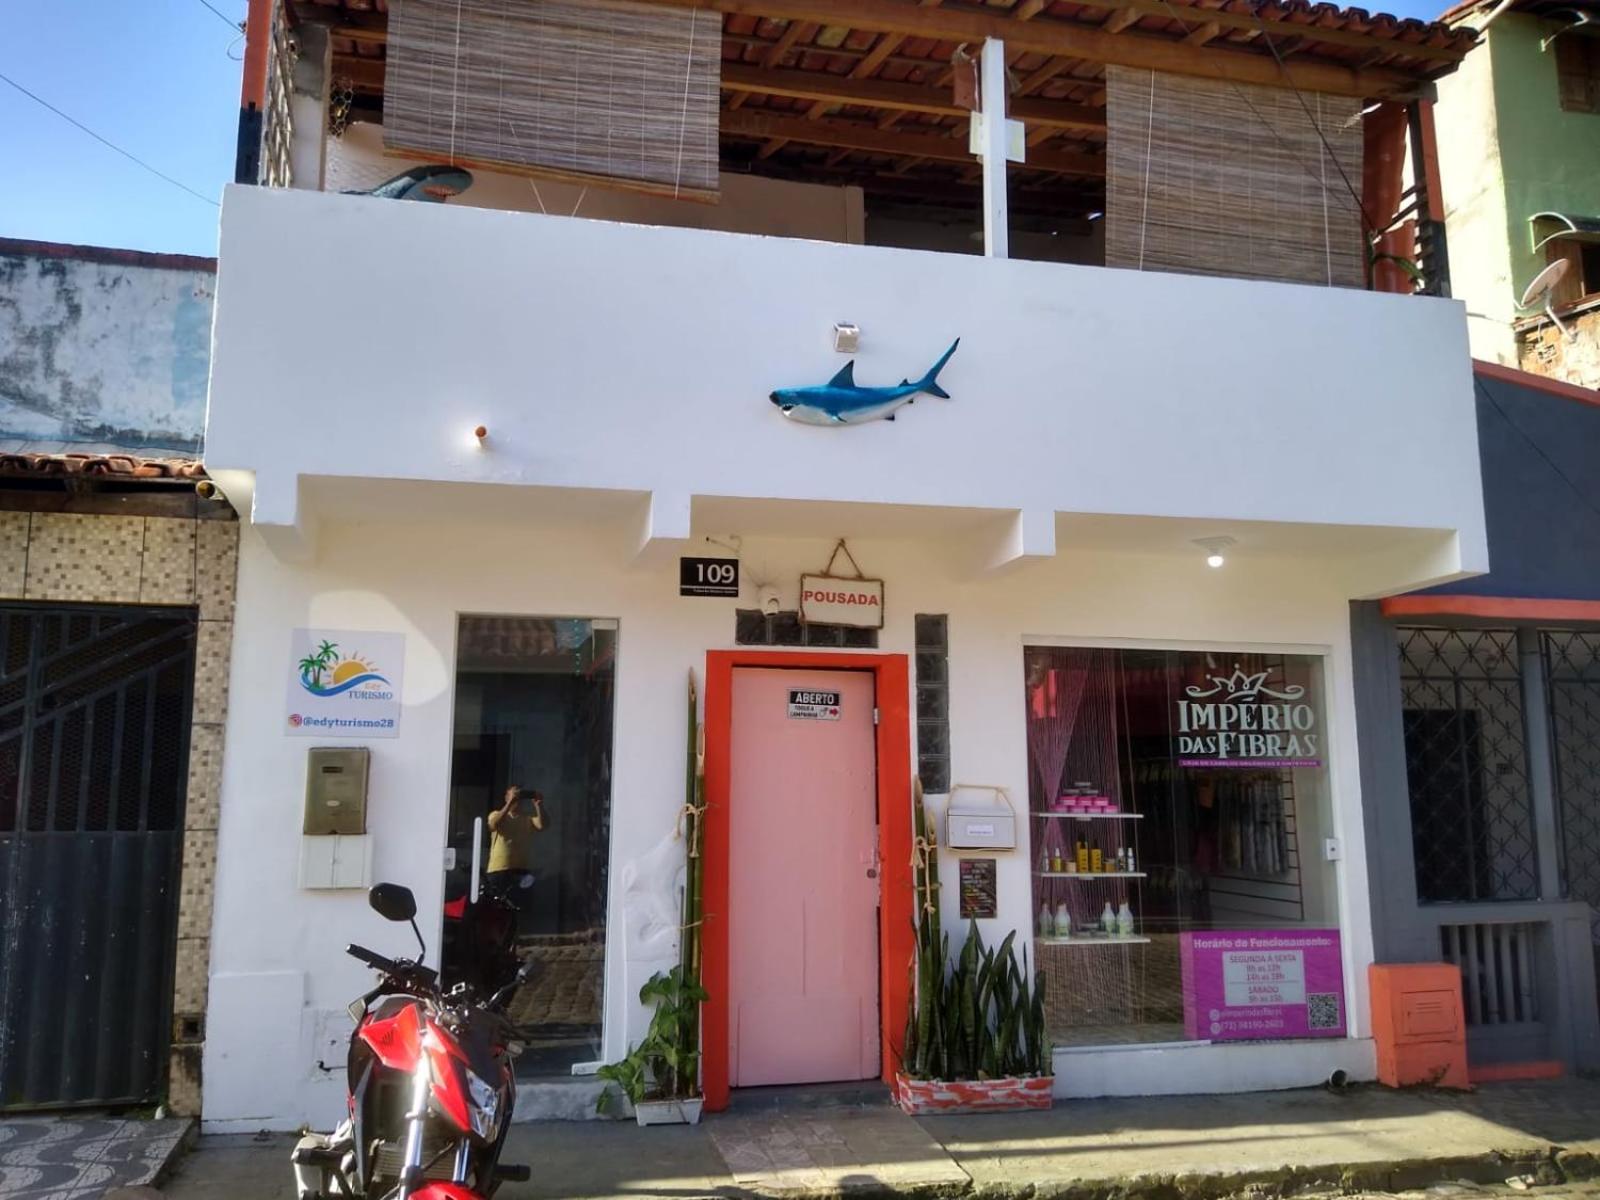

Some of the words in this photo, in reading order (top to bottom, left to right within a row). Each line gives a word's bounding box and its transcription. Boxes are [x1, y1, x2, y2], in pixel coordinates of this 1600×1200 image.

[696, 564, 735, 583] 109
[804, 591, 879, 606] POUSADA
[349, 691, 393, 700] TURISMO
[795, 692, 834, 705] ABERTO
[1179, 736, 1217, 754] DAS
[1217, 732, 1317, 759] FIBRAS
[1194, 938, 1233, 949] Horário
[1234, 938, 1248, 948] de
[1230, 954, 1265, 963] SEGUNDA
